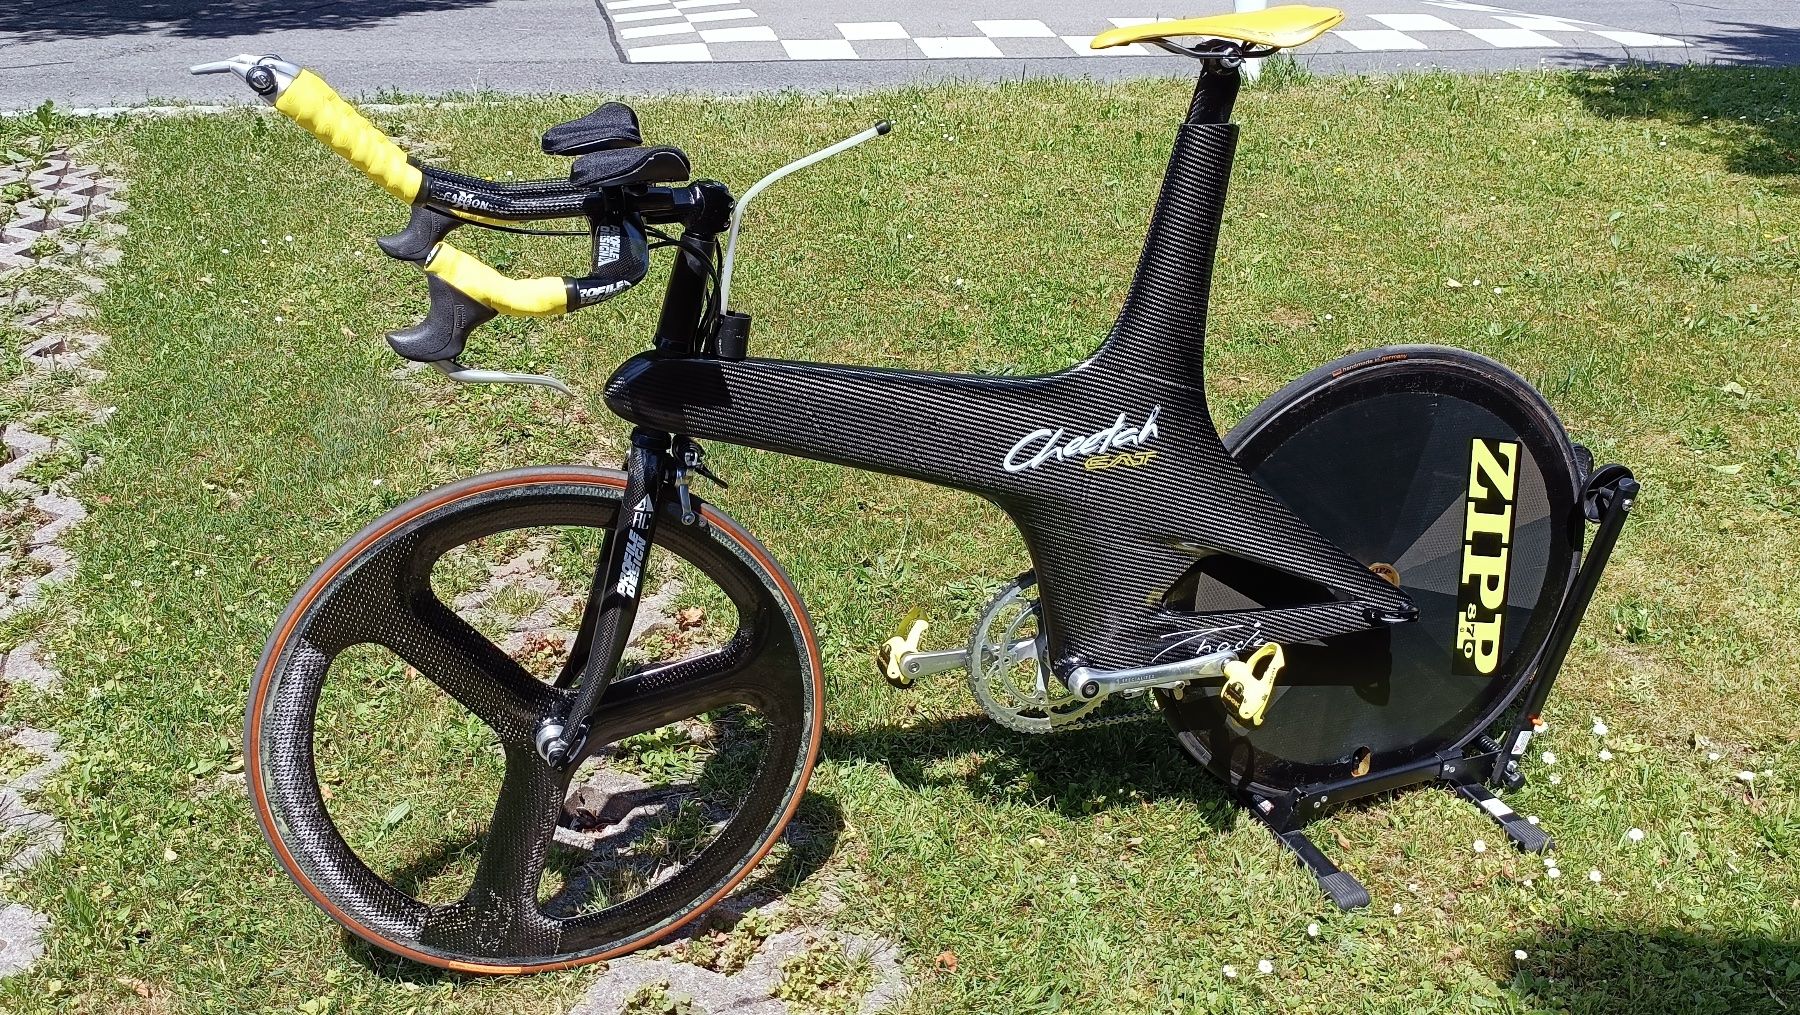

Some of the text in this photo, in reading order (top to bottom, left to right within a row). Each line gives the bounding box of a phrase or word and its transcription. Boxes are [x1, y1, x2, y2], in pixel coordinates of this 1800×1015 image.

[444, 191, 489, 210] CARBON
[599, 225, 610, 262] DESIGN
[610, 224, 620, 260] PROFILE
[580, 280, 624, 297] ROFILE
[1003, 404, 1162, 472] Cheetah
[632, 512, 651, 529] AC
[617, 529, 637, 598] PROFILE
[626, 534, 646, 598] DESIGN
[1456, 438, 1518, 674] ZIPP
[1464, 602, 1477, 659] 870
[1223, 692, 1240, 708] LOOK
